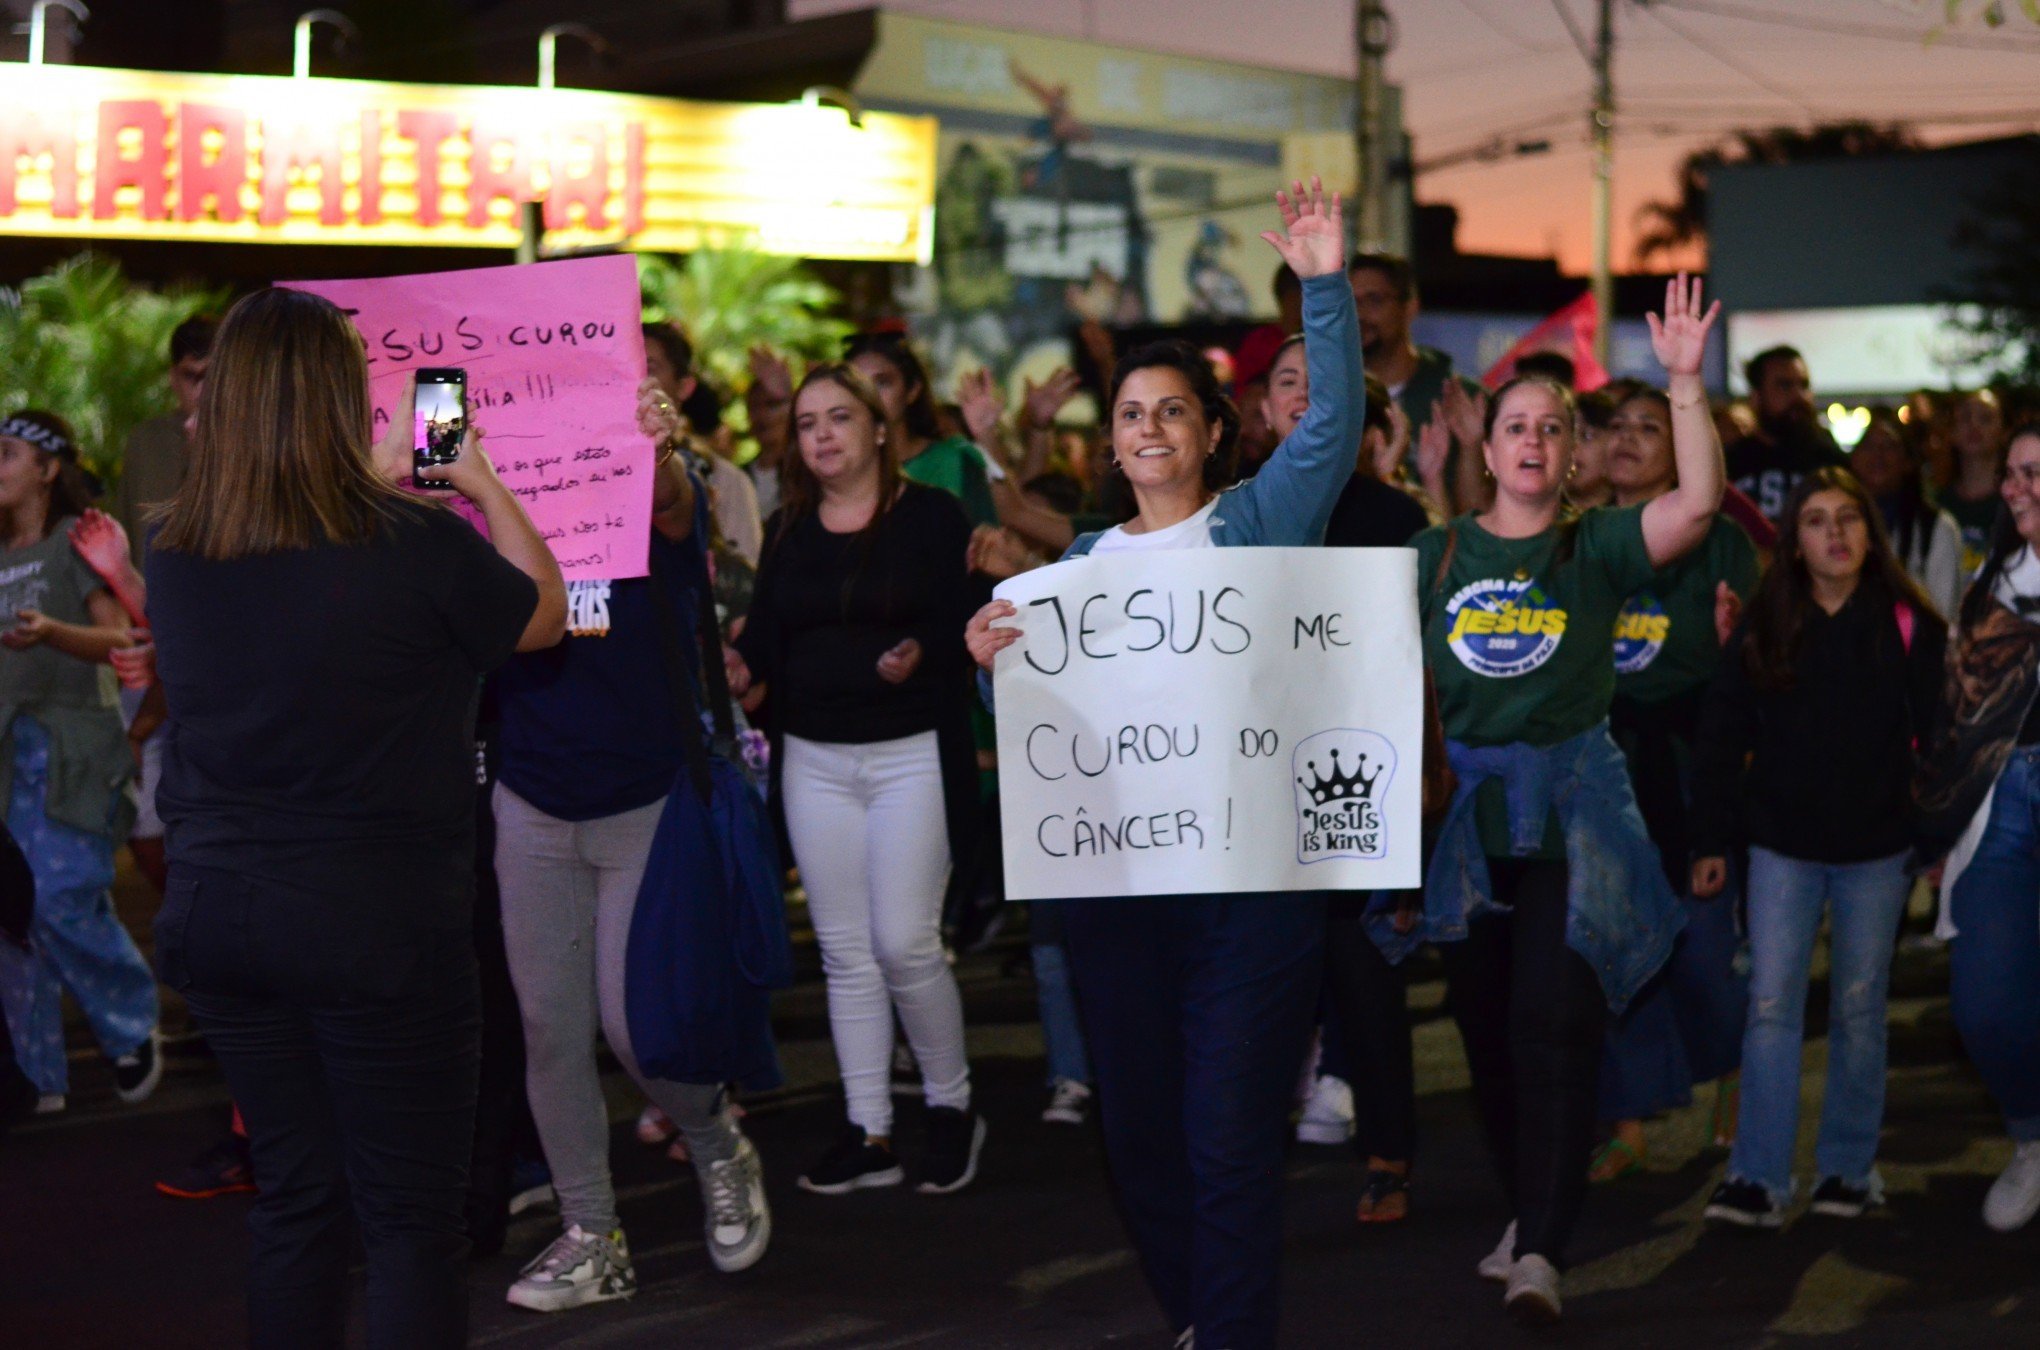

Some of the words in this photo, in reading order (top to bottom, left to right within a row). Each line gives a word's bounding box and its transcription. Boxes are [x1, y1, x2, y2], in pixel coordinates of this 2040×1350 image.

[338, 308, 484, 363] SUS
[509, 320, 616, 347] CUROU
[534, 456, 563, 477] que
[573, 446, 612, 462] estão
[1023, 586, 1252, 676] JESUS
[1293, 612, 1352, 652] ME
[1447, 606, 1568, 644] JESUS
[1026, 722, 1200, 782] CUROU
[1238, 727, 1280, 759] DO
[1037, 805, 1205, 858] CÂNCER
[1303, 831, 1321, 853] is
[1326, 831, 1379, 854] king
